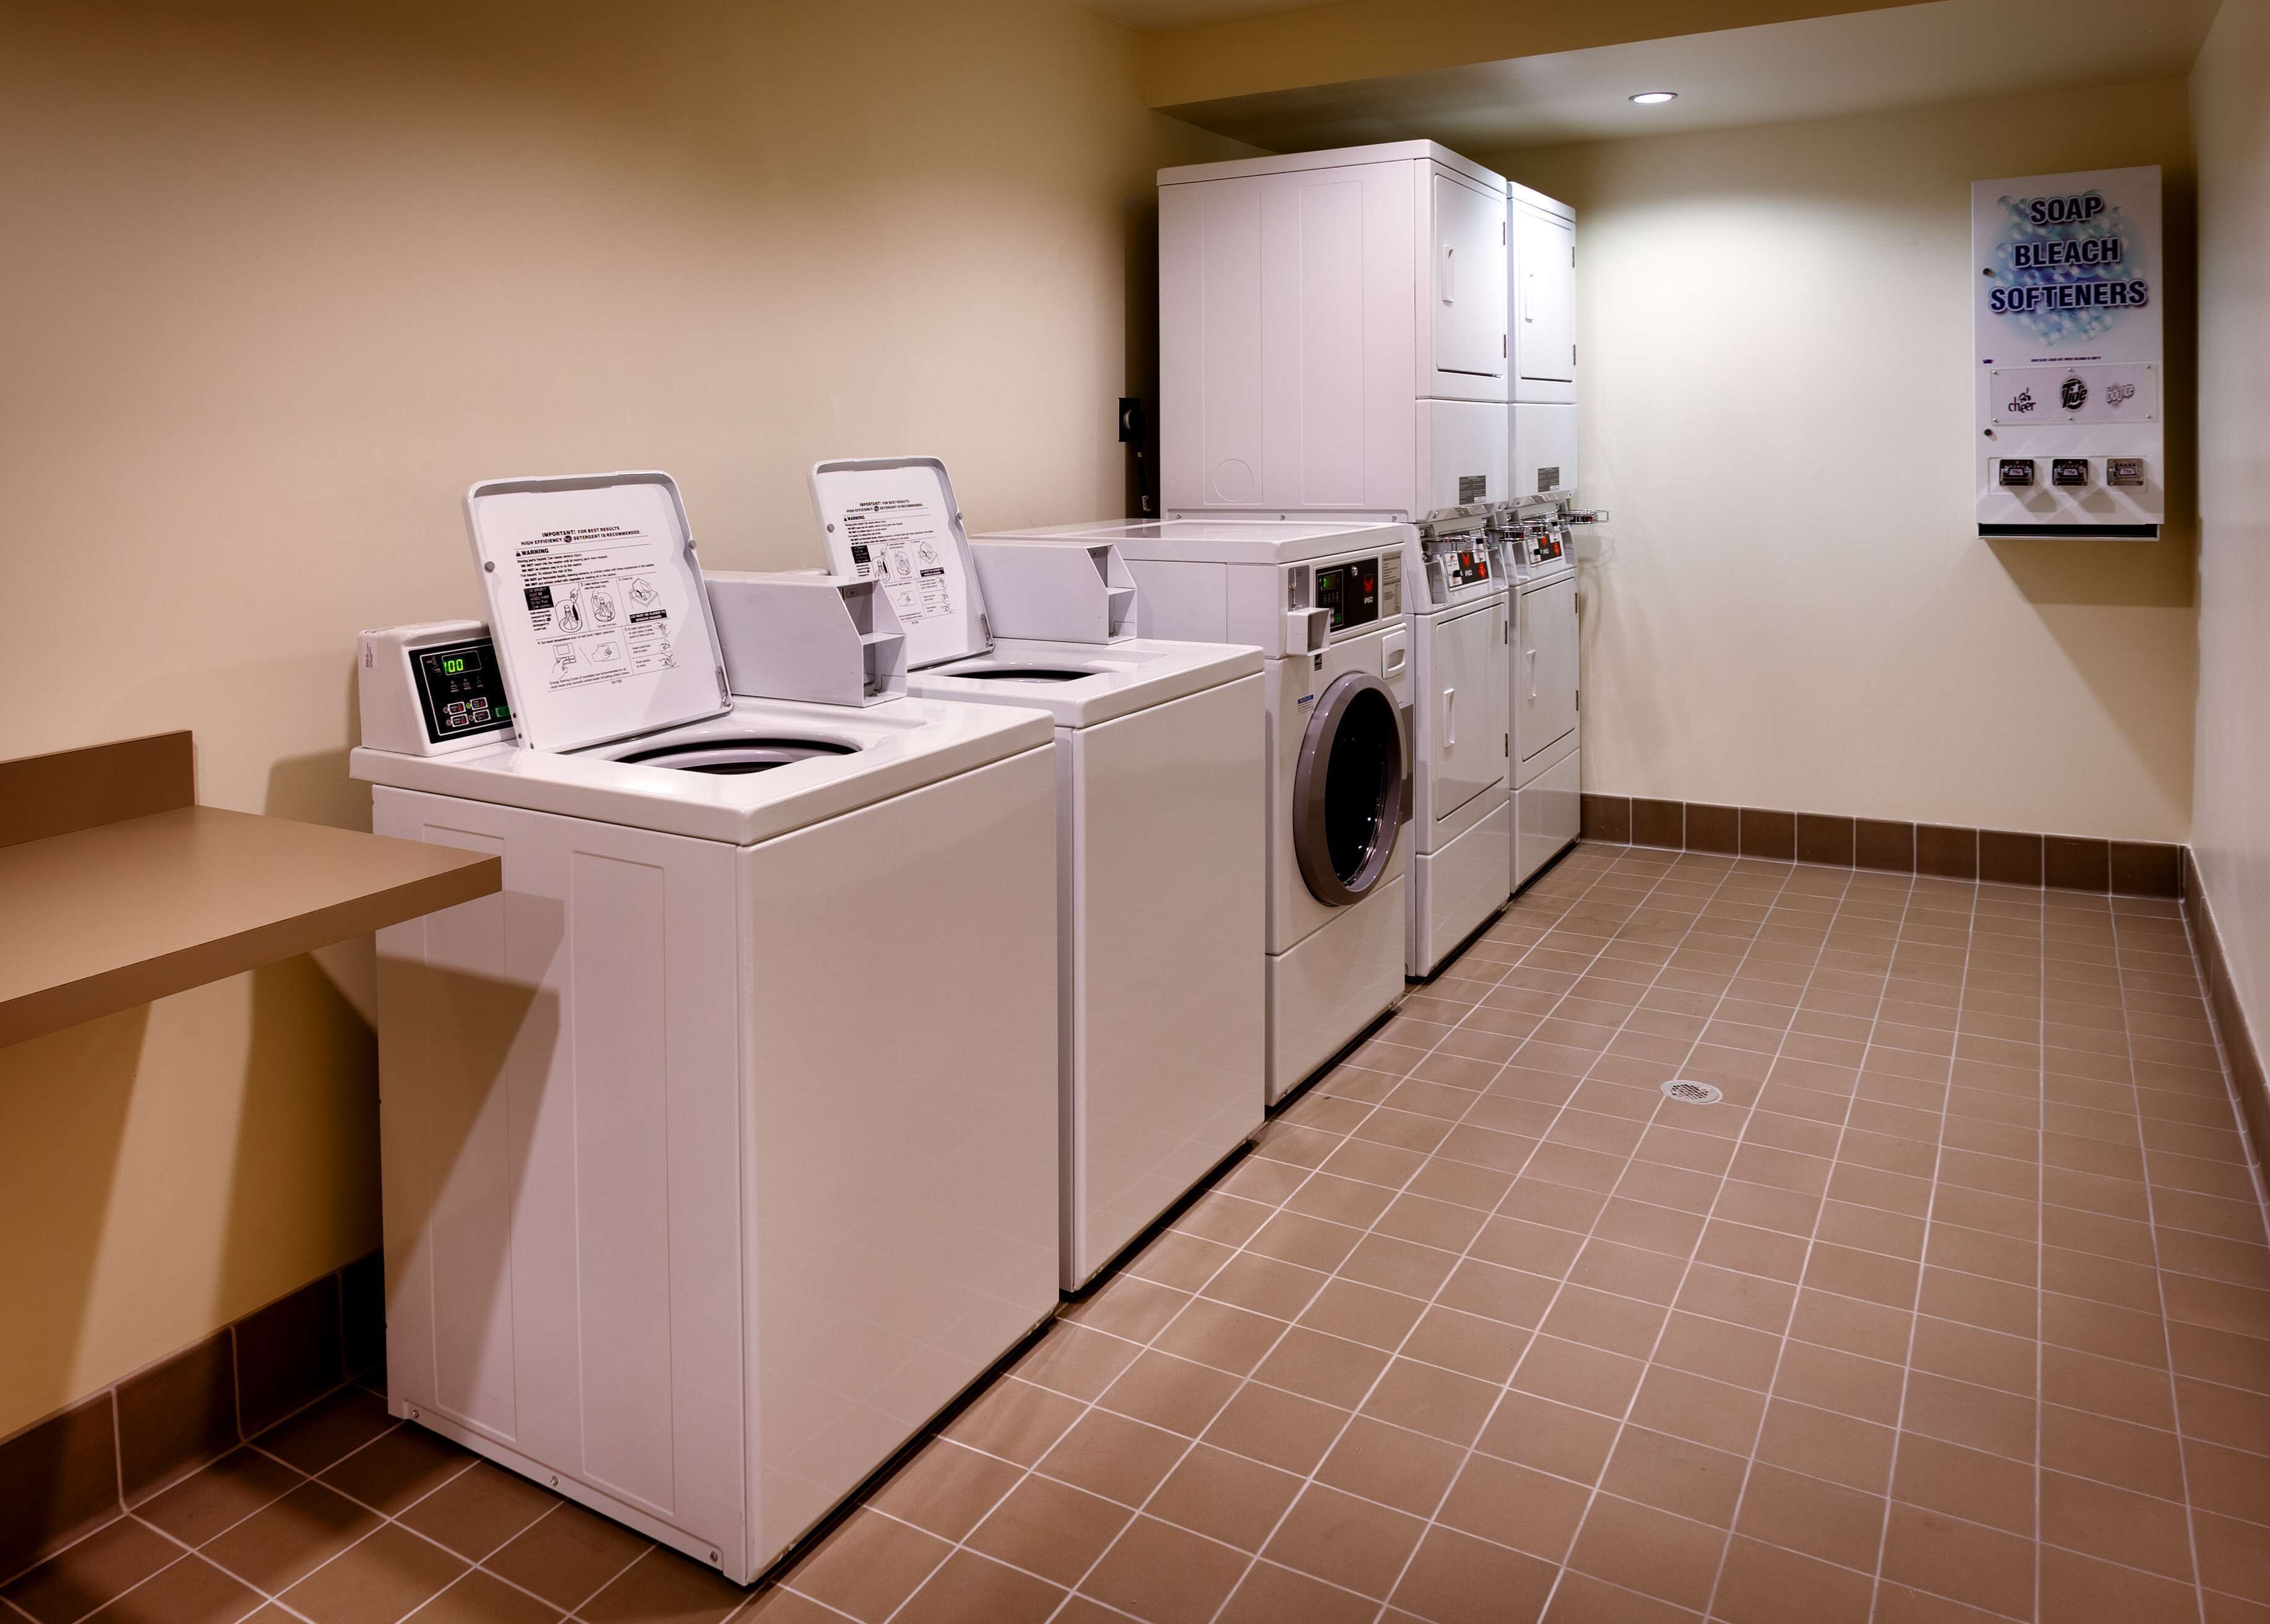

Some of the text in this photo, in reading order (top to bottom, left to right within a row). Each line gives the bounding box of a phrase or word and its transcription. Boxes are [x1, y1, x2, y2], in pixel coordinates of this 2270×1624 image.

[2030, 195, 2103, 223] SOAP
[2014, 238, 2120, 267] BLEACH
[1990, 280, 2146, 311] SOFTENERS
[2008, 397, 2036, 413] cheer
[2062, 380, 2087, 408] Tide
[444, 659, 463, 672] 100
